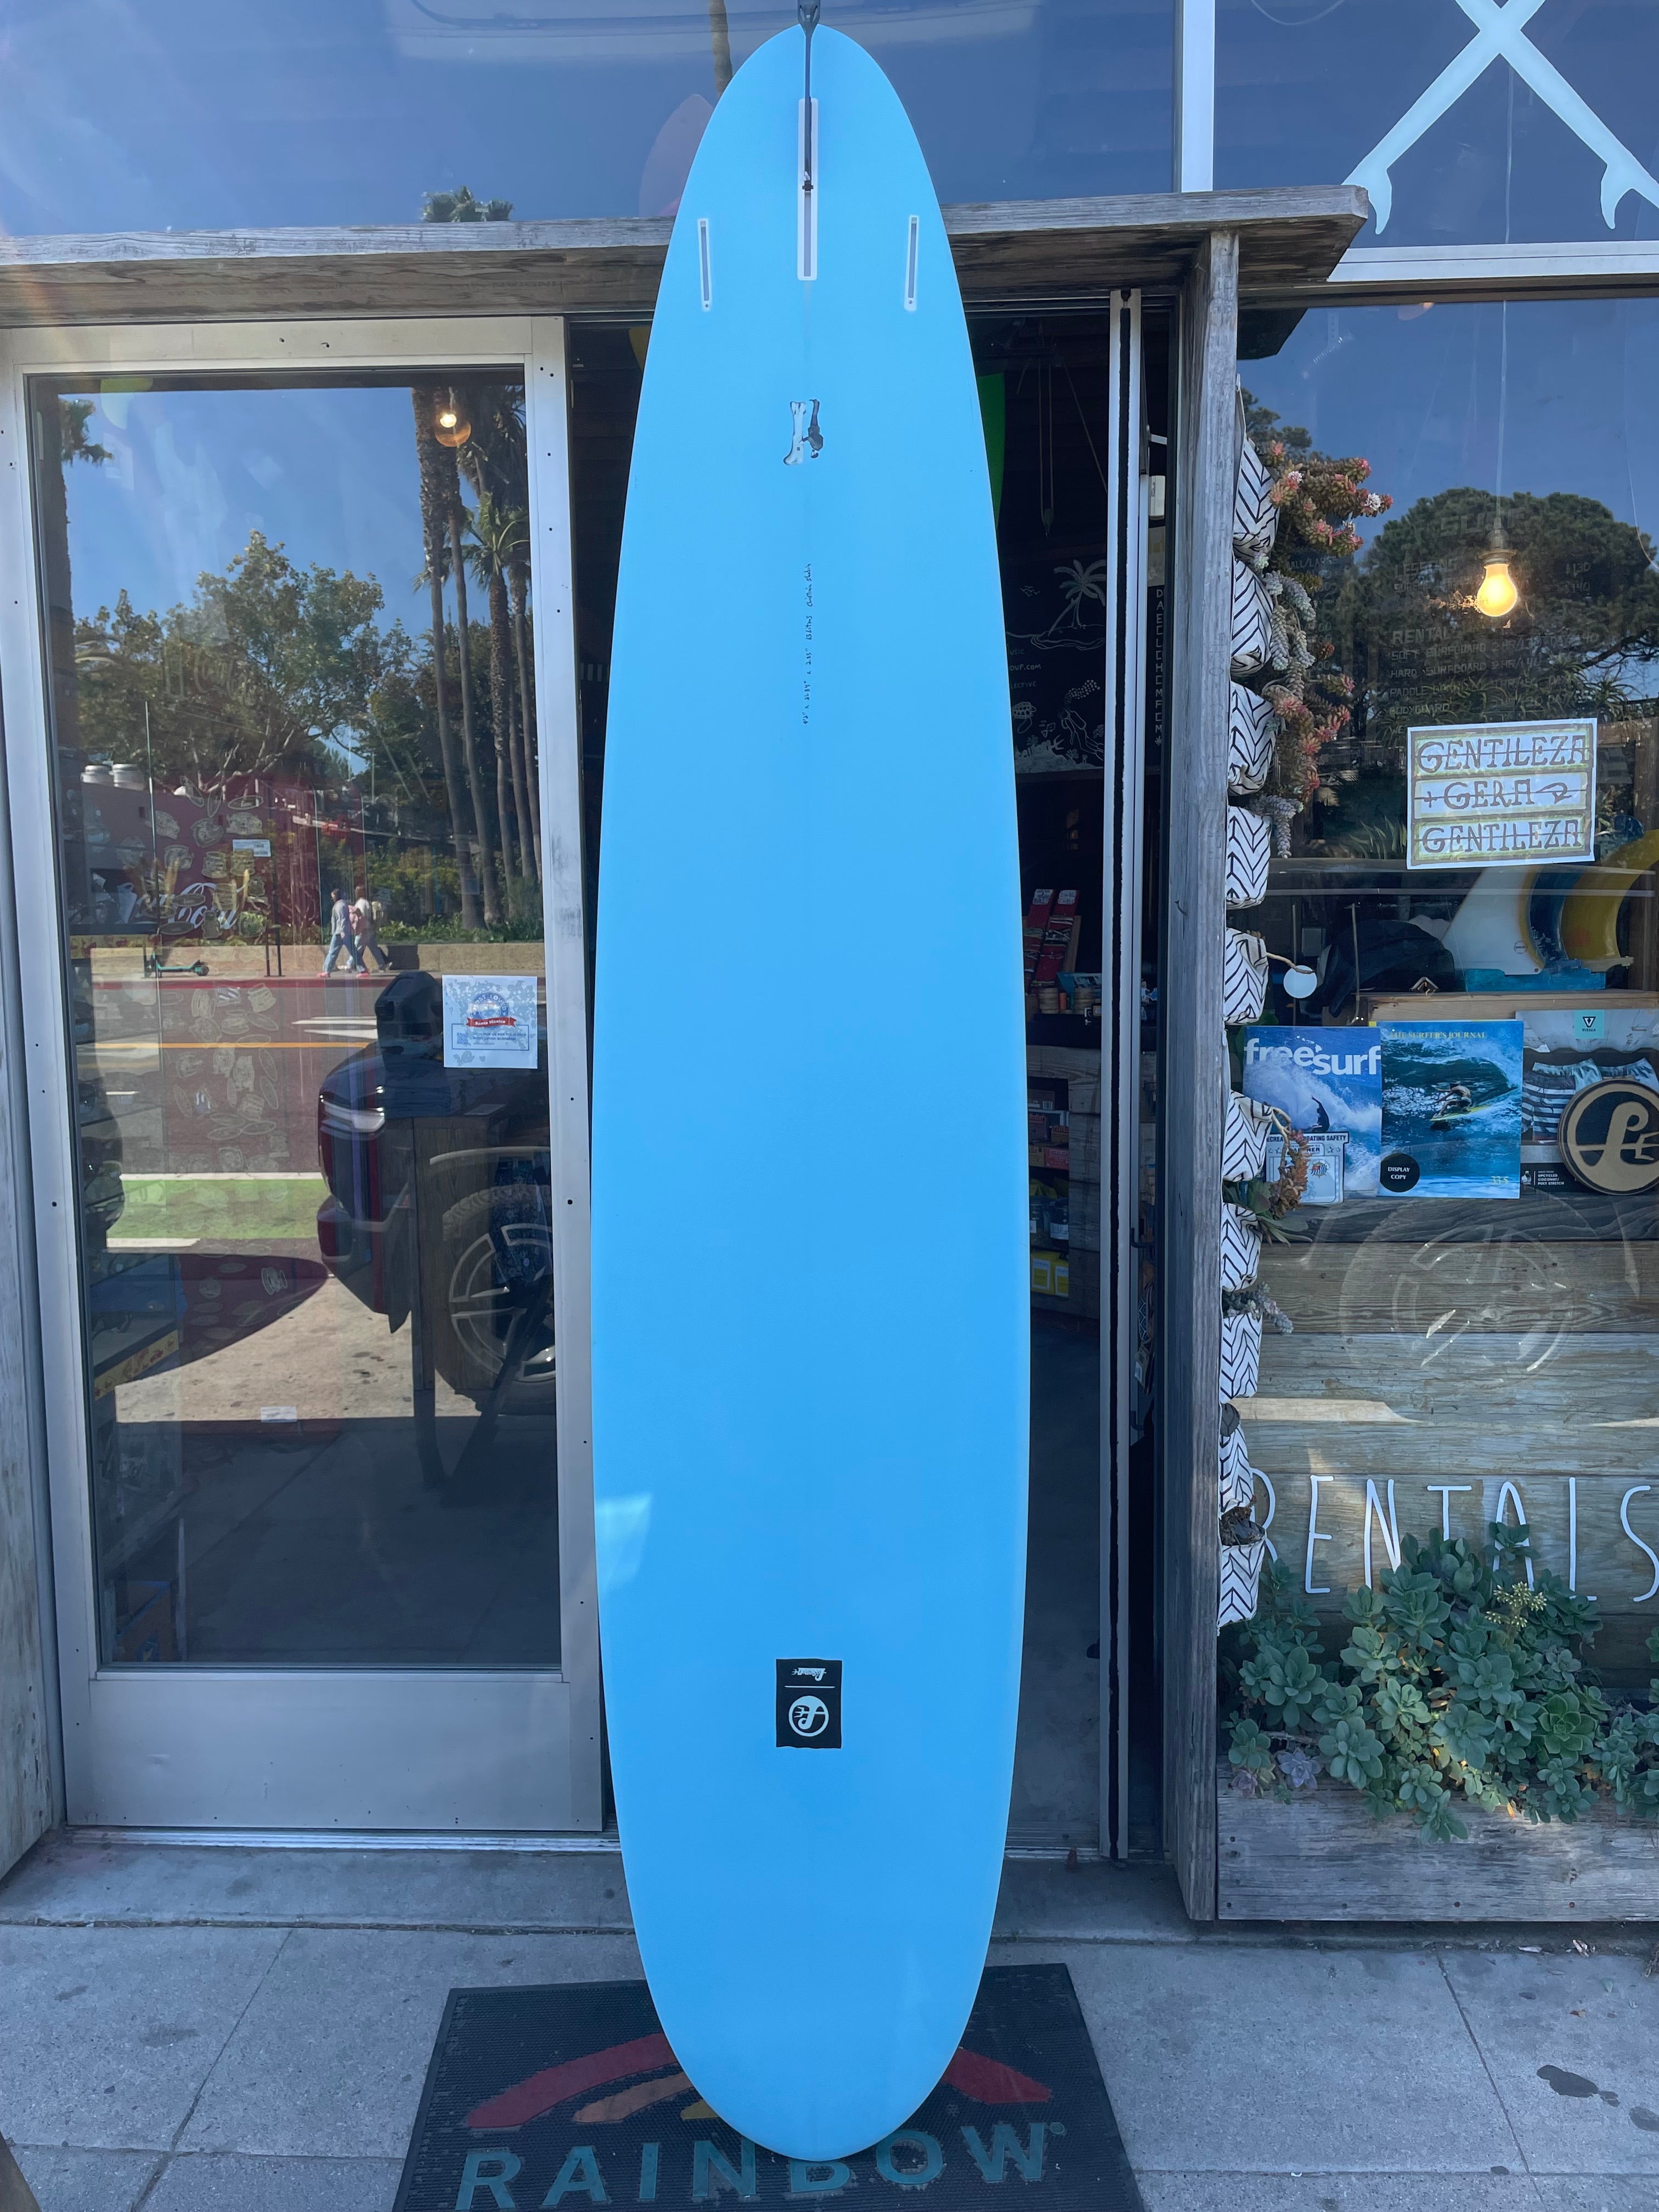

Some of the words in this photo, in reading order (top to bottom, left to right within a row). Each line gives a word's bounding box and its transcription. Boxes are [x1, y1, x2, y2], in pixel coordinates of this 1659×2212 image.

[1009, 663, 1042, 672] DUP.COM
[1416, 734, 1588, 774] GENTILEZA
[1444, 779, 1536, 809] GERA
[1421, 819, 1582, 854] GENTILEZA
[490, 994, 507, 1011] LOVED
